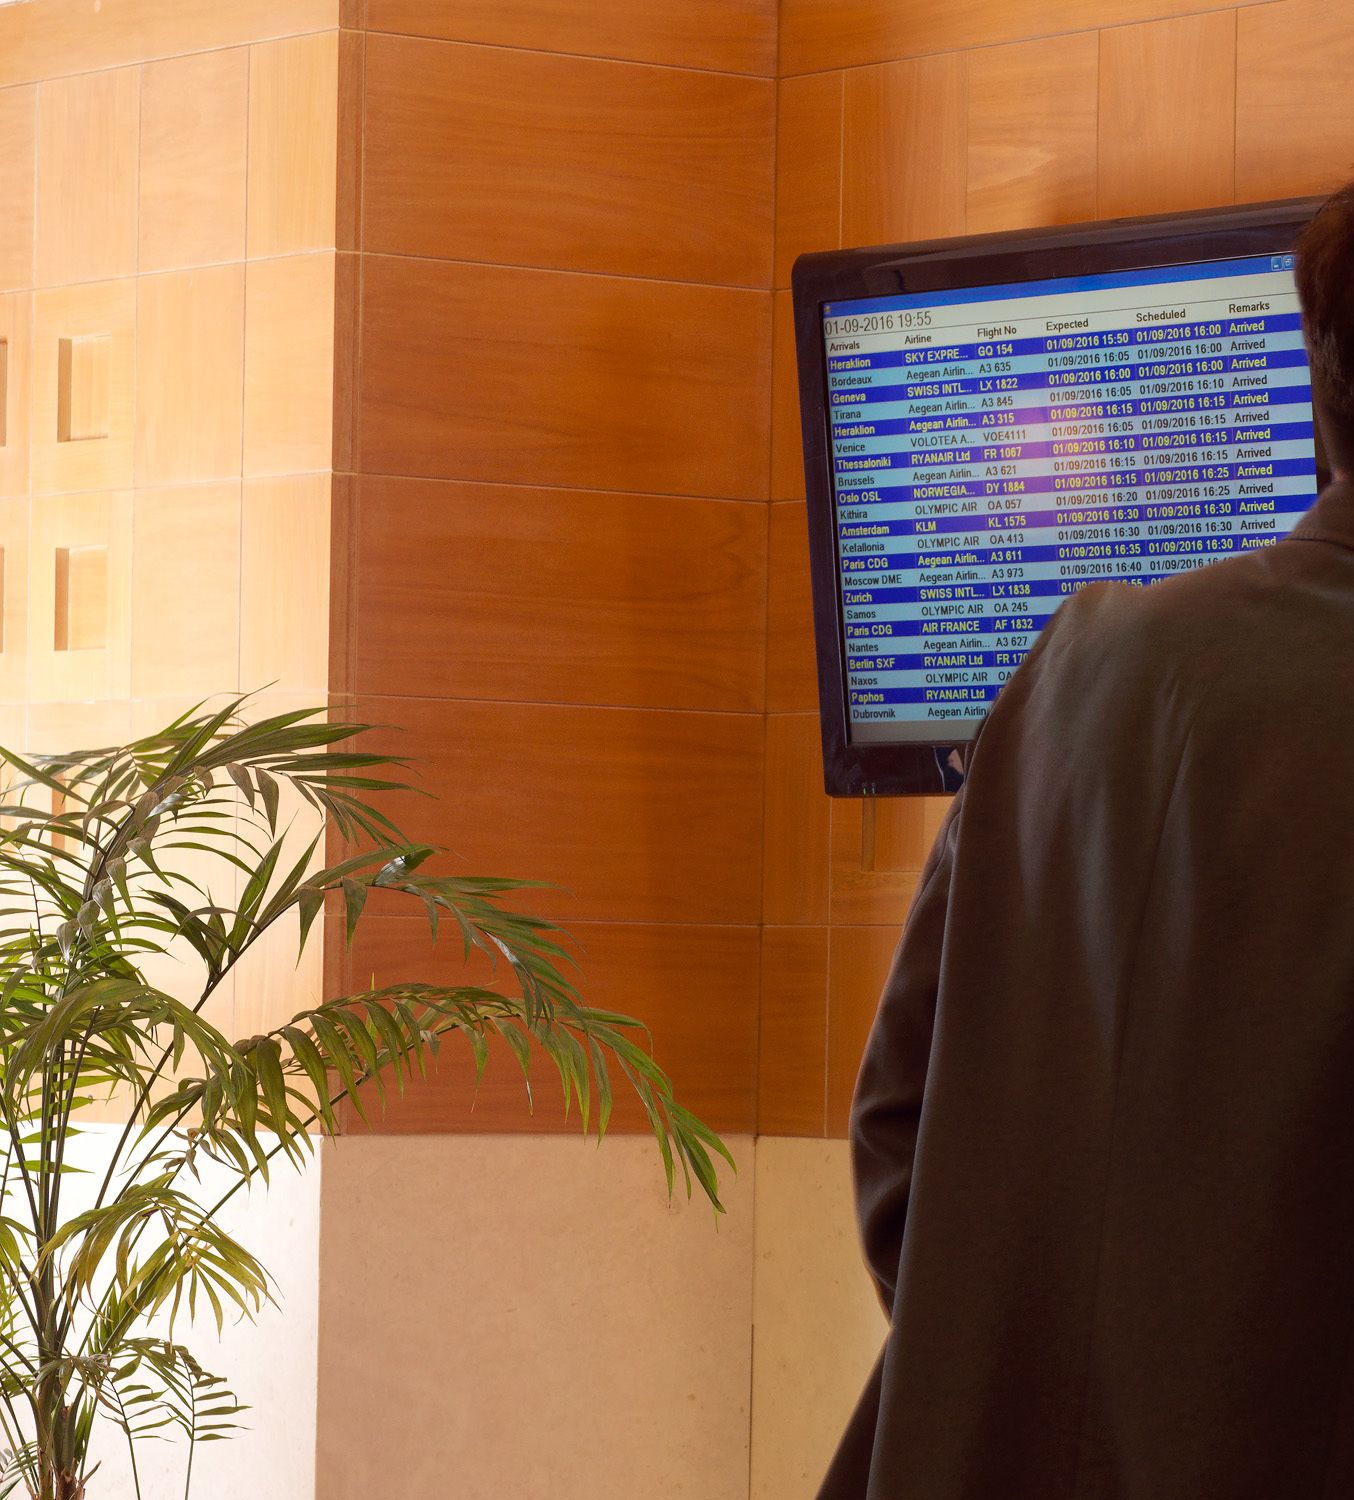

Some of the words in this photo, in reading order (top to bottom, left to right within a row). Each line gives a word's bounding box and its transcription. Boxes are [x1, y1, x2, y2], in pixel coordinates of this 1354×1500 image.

[824, 316, 893, 336] 01-09-2016
[898, 312, 931, 329] 19:55
[828, 340, 860, 352] Arrivals
[904, 334, 932, 345] Airline
[977, 327, 1002, 340] Flight
[1004, 325, 1017, 336] No
[1046, 319, 1089, 333] Expected
[1136, 309, 1186, 323] Scheduled
[1228, 301, 1270, 315] Remarks
[830, 357, 871, 370] Heraklion
[905, 352, 925, 363] SKY
[977, 346, 993, 358] GQ
[996, 344, 1013, 355] 154
[1046, 336, 1099, 350] 01/09/2016
[1102, 334, 1128, 345] 15:50
[1136, 328, 1190, 342] 01/09/2016
[1194, 325, 1221, 337] 16:00
[1228, 321, 1265, 334] Arrived
[832, 392, 866, 403] Geneva
[907, 385, 939, 397] SWISS
[979, 381, 992, 391] LX
[995, 379, 1018, 389] 1822
[1048, 371, 1101, 385] 01/09/2016
[1104, 369, 1130, 380] 16:00
[1138, 364, 1192, 377] 01/09/2016
[1196, 361, 1223, 373] 16:00
[1231, 357, 1266, 370] Arrived
[837, 457, 891, 470] Thessaloniki
[911, 453, 954, 465] RYANAIR
[956, 451, 970, 461] Ltd
[984, 449, 997, 459] FR
[1000, 448, 1022, 458] 1067
[1052, 441, 1105, 454] 01/09/2016
[1109, 439, 1135, 450] 16:10
[1142, 435, 1197, 448] 01/09/2016
[1200, 432, 1227, 444] 16:15
[1234, 429, 1270, 441] Arrived
[839, 509, 868, 520] Kithira
[915, 504, 958, 515] OLYMPIC
[961, 502, 977, 512] AIR
[987, 501, 1002, 511] OA
[1004, 499, 1022, 509] 057
[1056, 494, 1108, 506] 01/09/2016
[1112, 492, 1138, 503] 16:20
[1145, 488, 1200, 501] 01/09/2016
[1203, 486, 1230, 497] 16:25
[1237, 483, 1273, 495] Arrived
[841, 525, 889, 536] Amsterdam
[915, 522, 936, 532] KLM
[988, 518, 1001, 528] KL
[1004, 516, 1026, 527] 1575
[1057, 511, 1109, 523] 01/09/2016
[1113, 509, 1139, 520] 16:30
[1146, 506, 1201, 518] 01/09/2016
[1204, 504, 1231, 515] 16:30
[1238, 501, 1274, 513] Arrived
[847, 626, 869, 636] Paris
[871, 625, 892, 635] CDG
[922, 623, 938, 633] AIR
[940, 622, 979, 632] FRANCE
[994, 620, 1008, 630] AF
[1010, 619, 1033, 629] 1832
